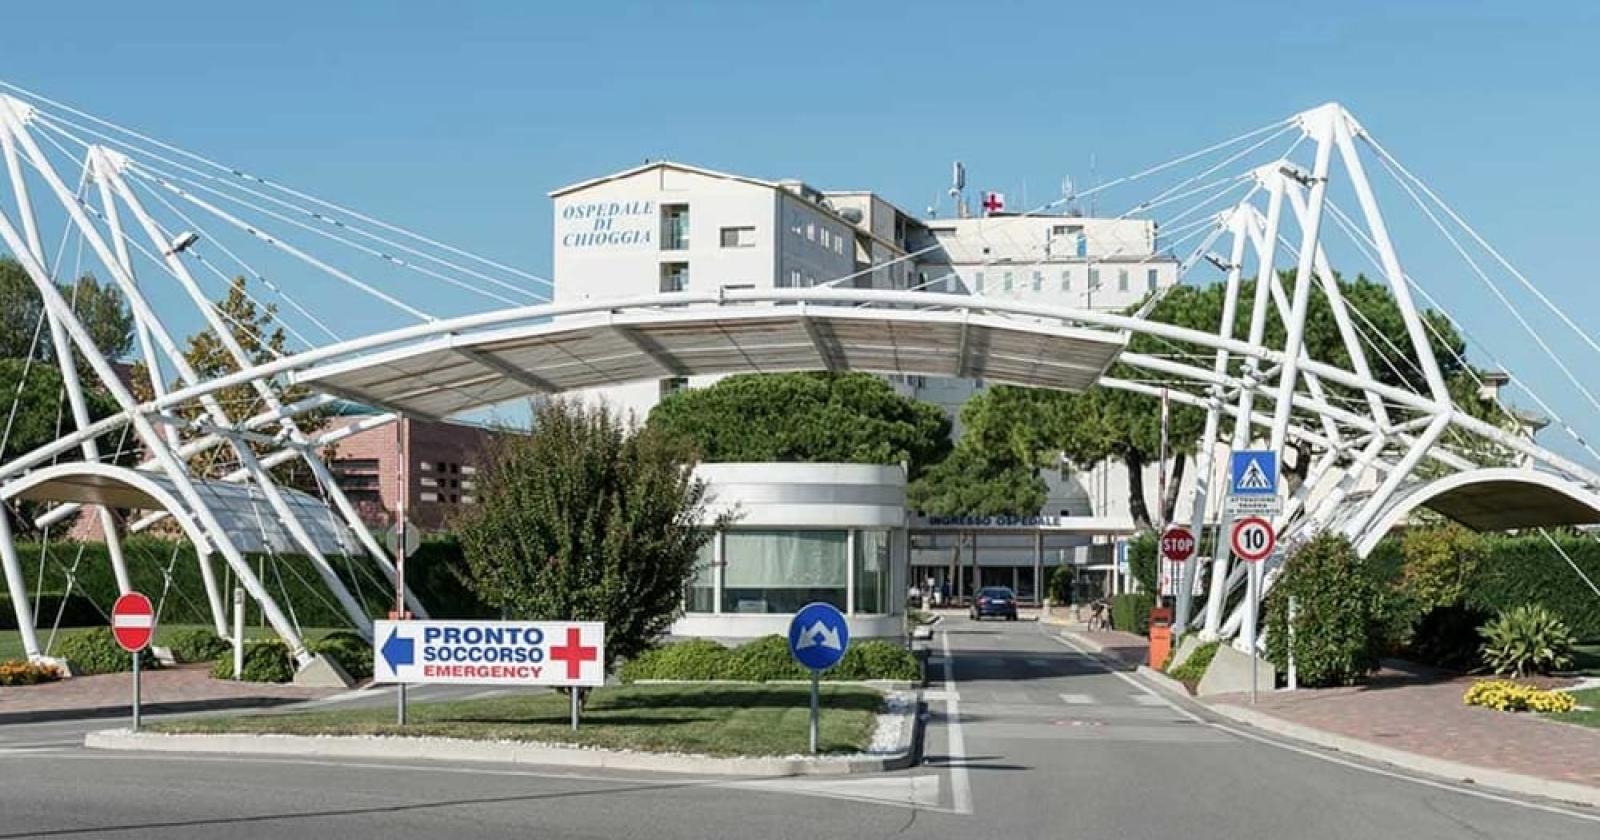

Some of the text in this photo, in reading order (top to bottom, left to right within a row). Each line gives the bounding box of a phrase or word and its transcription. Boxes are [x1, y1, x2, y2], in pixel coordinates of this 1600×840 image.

[563, 201, 654, 218] OSPEDALE
[593, 218, 612, 231] DI
[562, 230, 652, 247] CHIOGGIA
[929, 516, 1061, 526] INGRESSO OSPEDALE
[1163, 538, 1193, 552] STOP
[1244, 529, 1265, 549] 10
[423, 627, 544, 645] PRONTO
[423, 646, 544, 663] SOCCORSO
[423, 665, 542, 679] EMERGENCY
